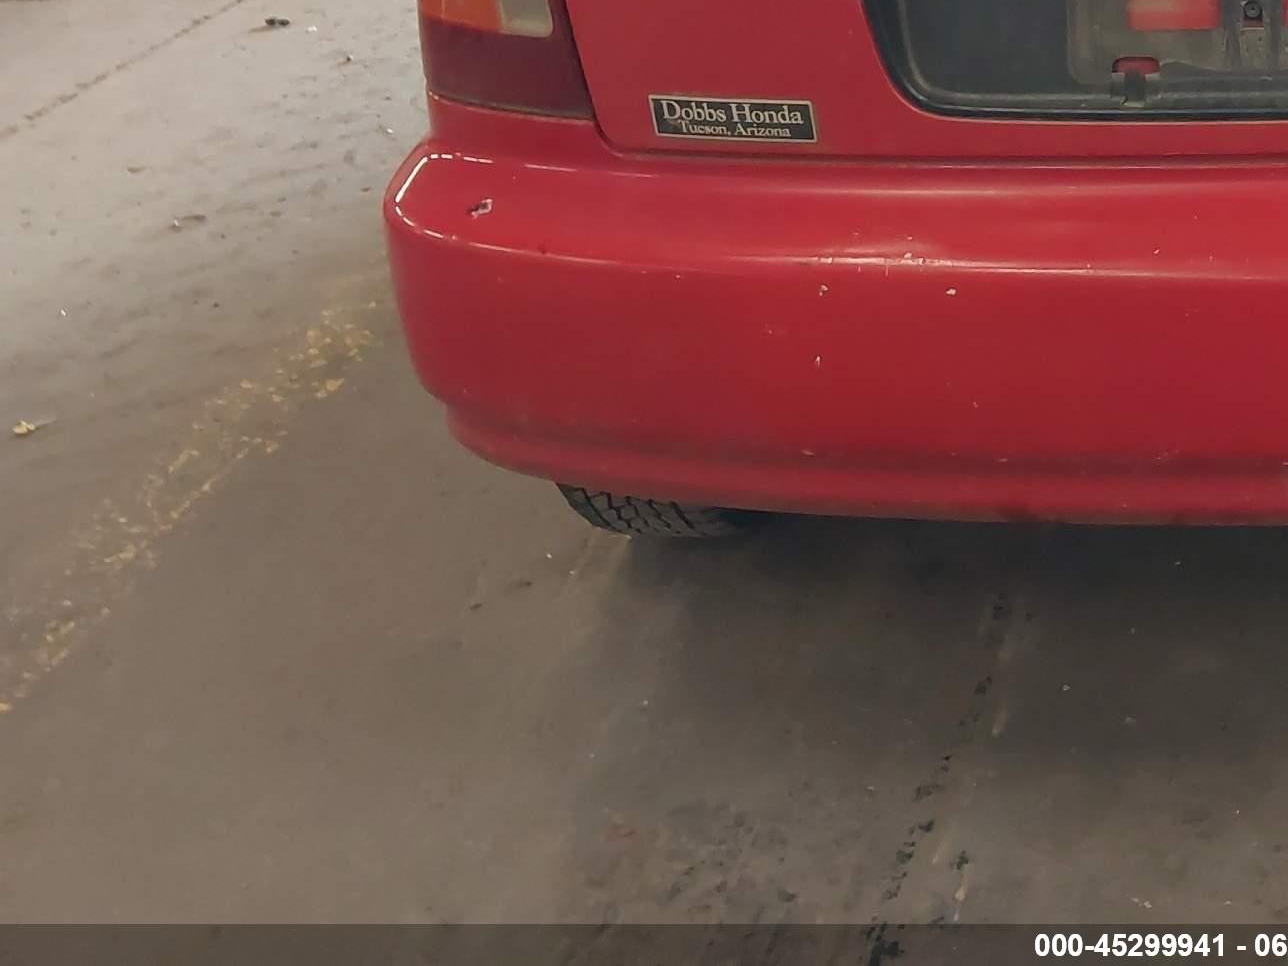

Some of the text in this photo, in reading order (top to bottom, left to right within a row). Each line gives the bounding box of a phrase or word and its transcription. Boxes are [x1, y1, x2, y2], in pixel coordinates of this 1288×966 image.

[660, 100, 805, 125] Dobbs Honda
[679, 121, 792, 138] Tucson, Arizona
